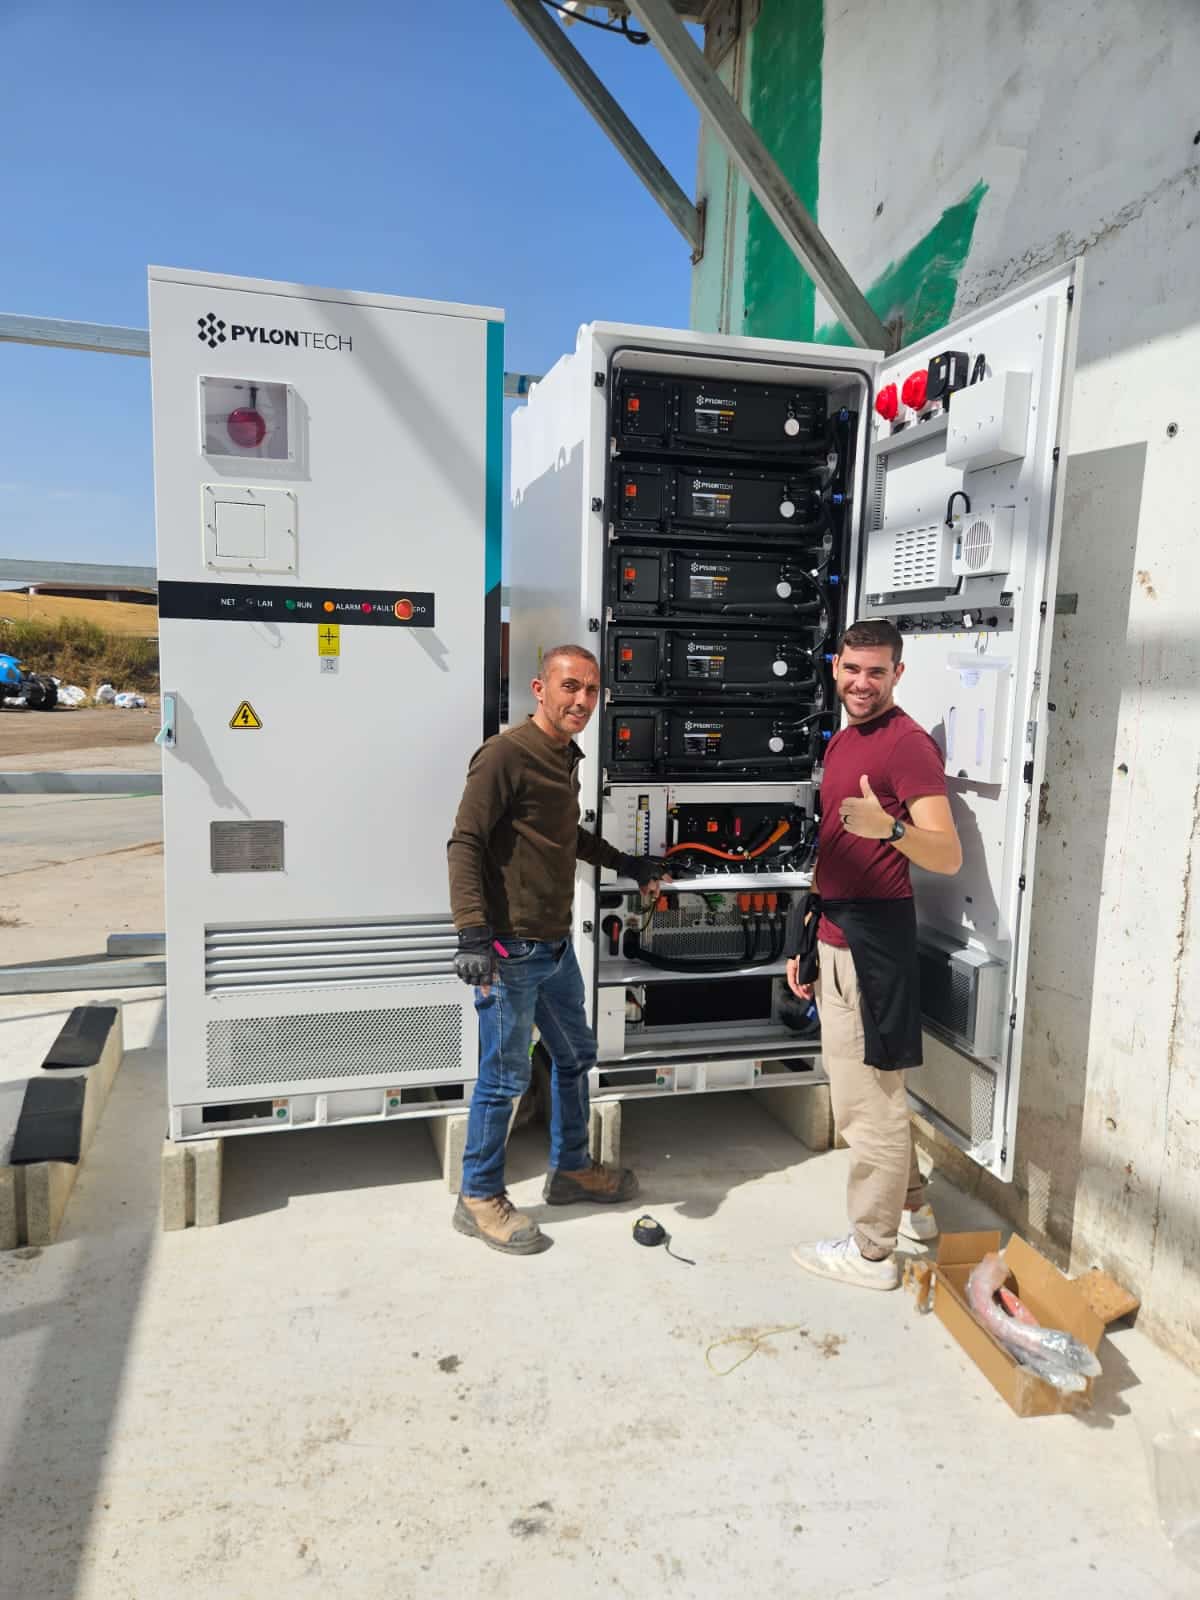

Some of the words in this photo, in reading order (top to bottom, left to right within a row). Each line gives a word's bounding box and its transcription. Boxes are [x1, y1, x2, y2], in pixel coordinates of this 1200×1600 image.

[231, 324, 353, 352] PYLONTECH
[220, 598, 236, 606] NET
[257, 599, 273, 607] LAN
[296, 600, 313, 609] RUN
[335, 602, 361, 610] ALARM
